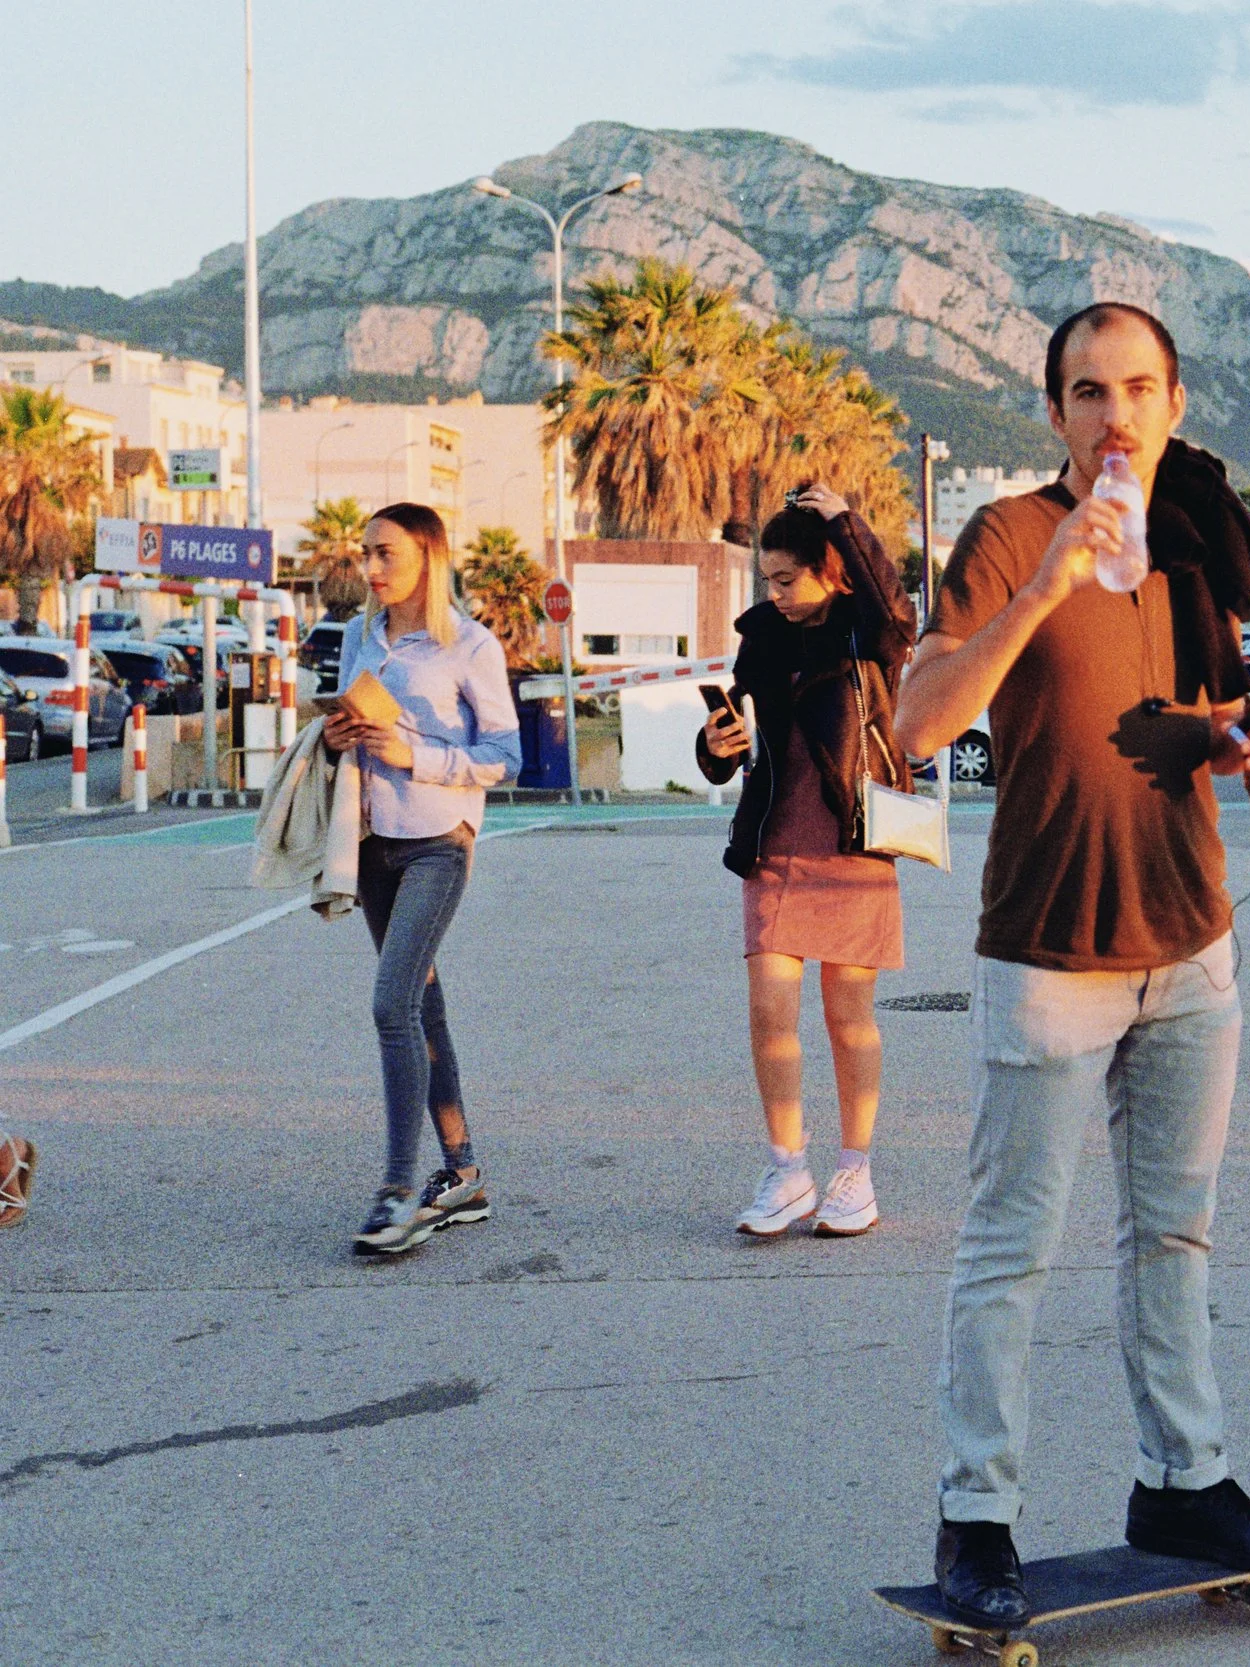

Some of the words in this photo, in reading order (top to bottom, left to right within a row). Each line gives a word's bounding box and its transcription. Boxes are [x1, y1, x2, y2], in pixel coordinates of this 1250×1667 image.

[170, 539, 186, 561] P6
[188, 541, 238, 564] PLAGES
[547, 596, 570, 610] STOP
